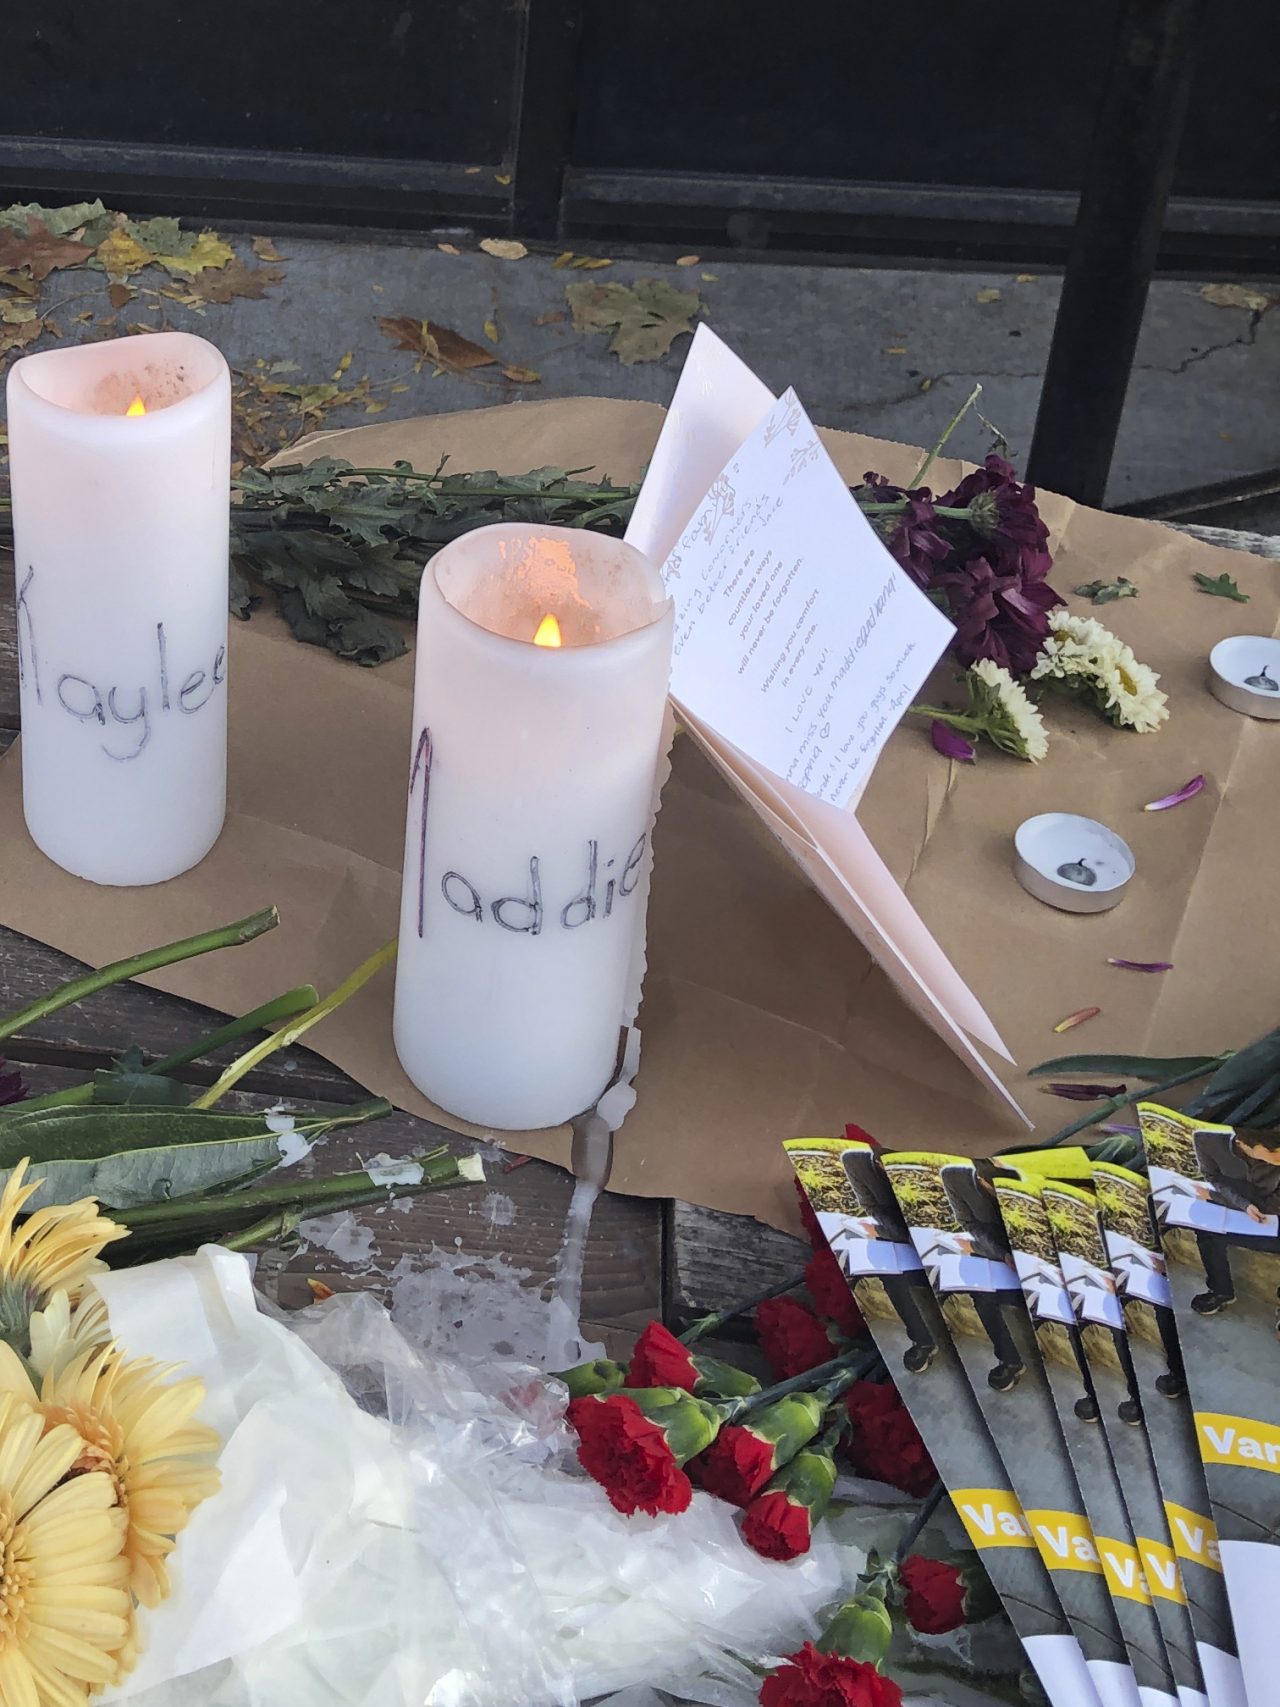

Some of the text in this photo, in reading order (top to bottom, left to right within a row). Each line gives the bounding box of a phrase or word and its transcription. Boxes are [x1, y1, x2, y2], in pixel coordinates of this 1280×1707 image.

[722, 548, 756, 598] There are
[726, 549, 773, 626] countless ways
[738, 560, 784, 640] your loved one
[736, 557, 805, 675] will never be forgotten.
[760, 587, 820, 694] Wishing you comfort
[778, 623, 819, 688] in every one.
[797, 720, 821, 756] miss
[816, 692, 835, 720] you
[838, 733, 856, 757] love
[828, 771, 850, 802] never
[847, 755, 861, 770] be
[961, 1503, 1032, 1537] Va
